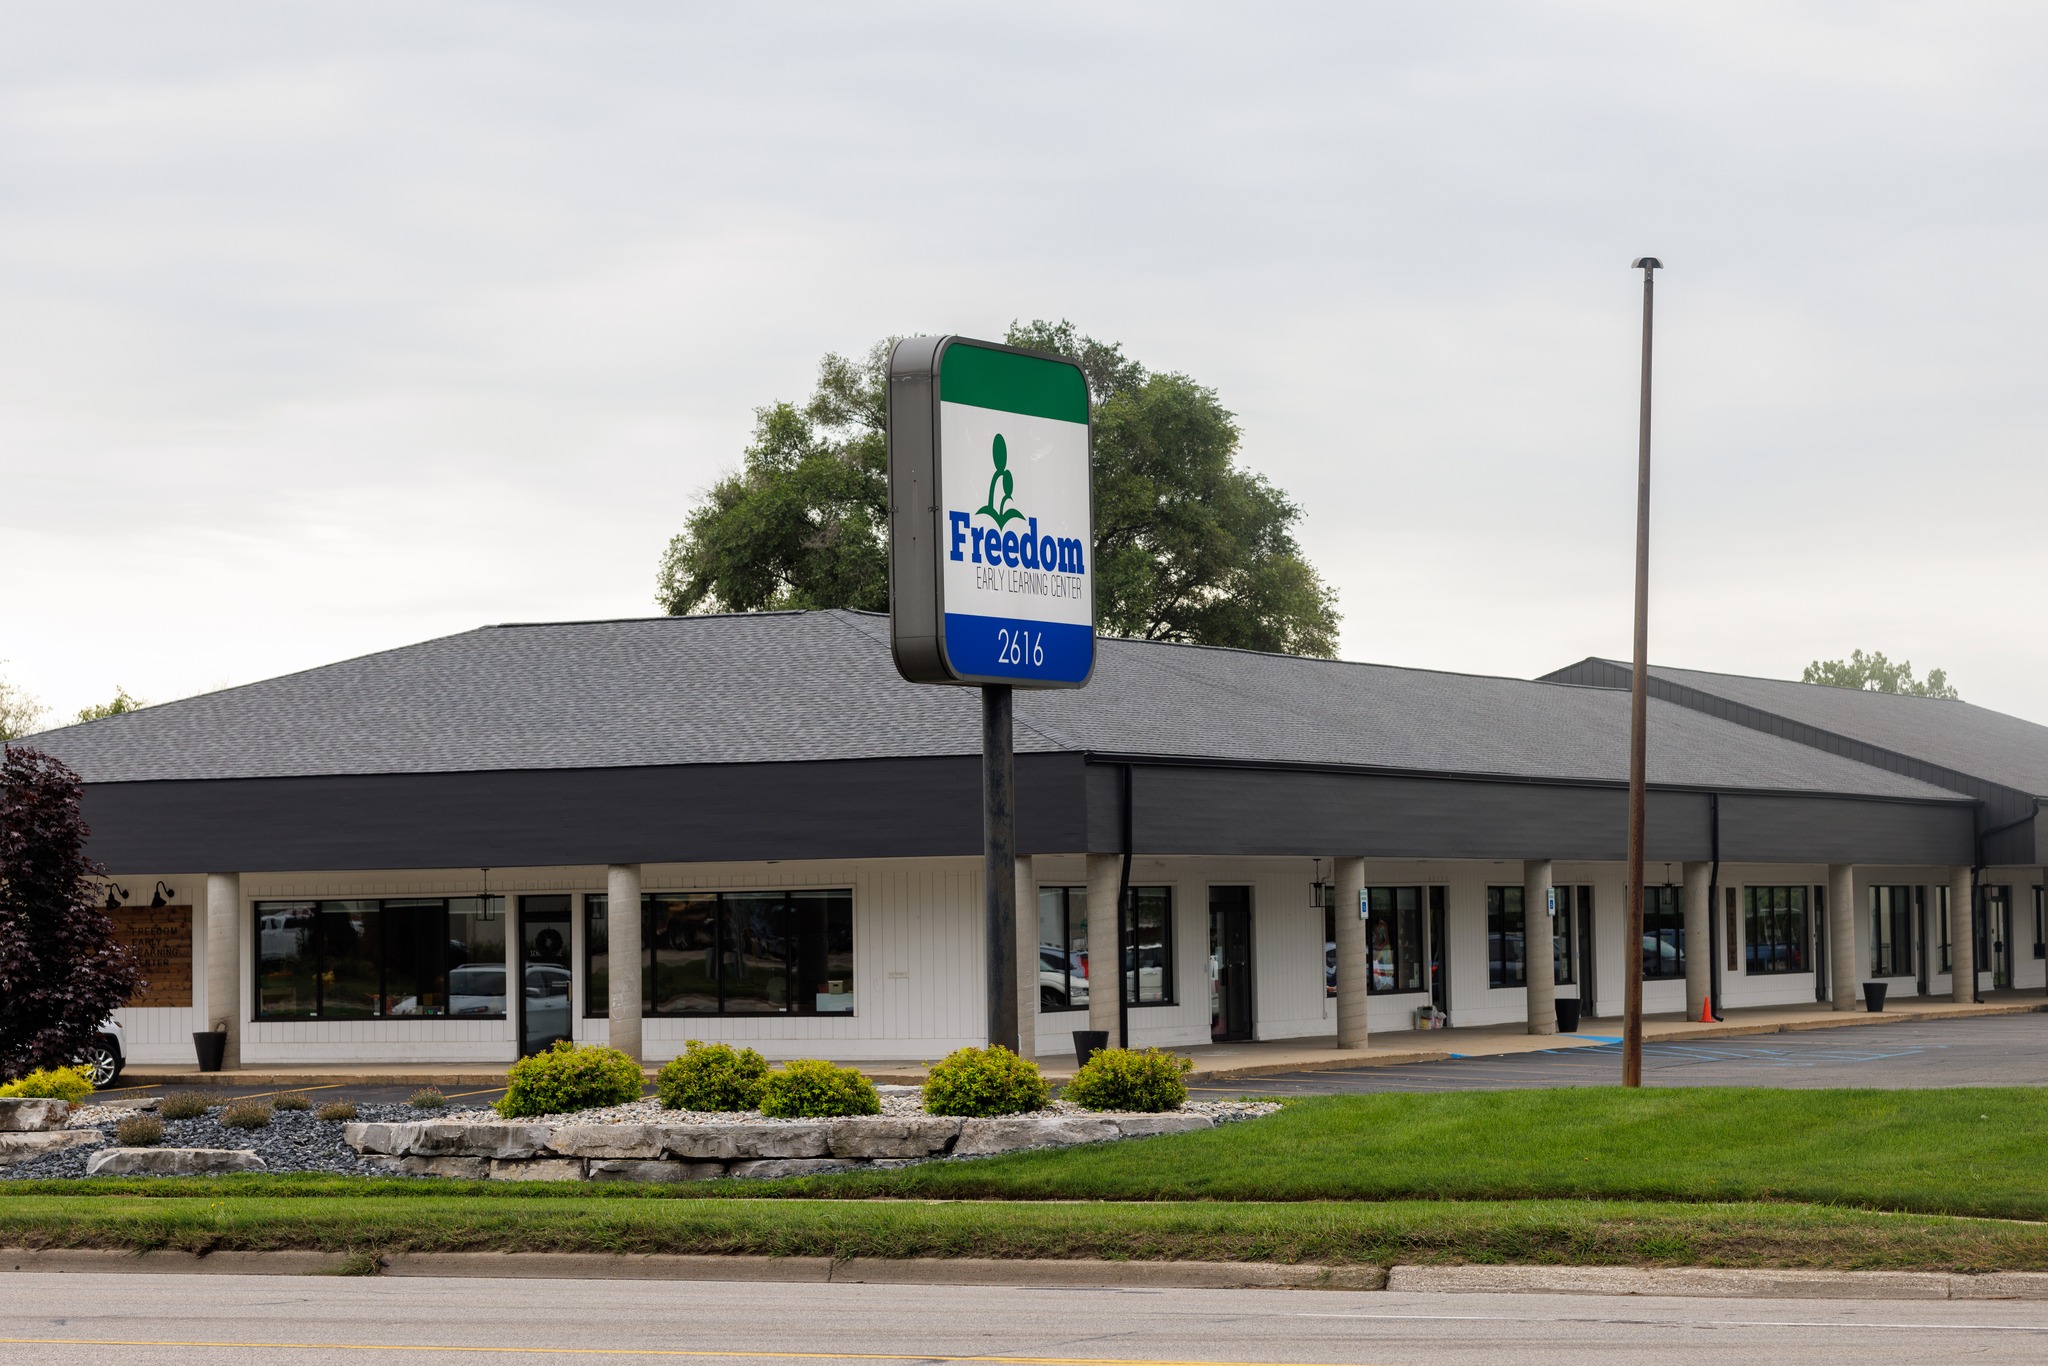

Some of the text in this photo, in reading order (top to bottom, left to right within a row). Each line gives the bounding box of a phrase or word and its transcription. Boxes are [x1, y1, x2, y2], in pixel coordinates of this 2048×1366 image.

[949, 510, 1085, 575] Freedom
[976, 566, 1082, 599] EARLY LEARNING CENTER
[998, 628, 1044, 666] 2616
[131, 927, 178, 935] FREEDOM
[131, 938, 162, 946] EARLY
